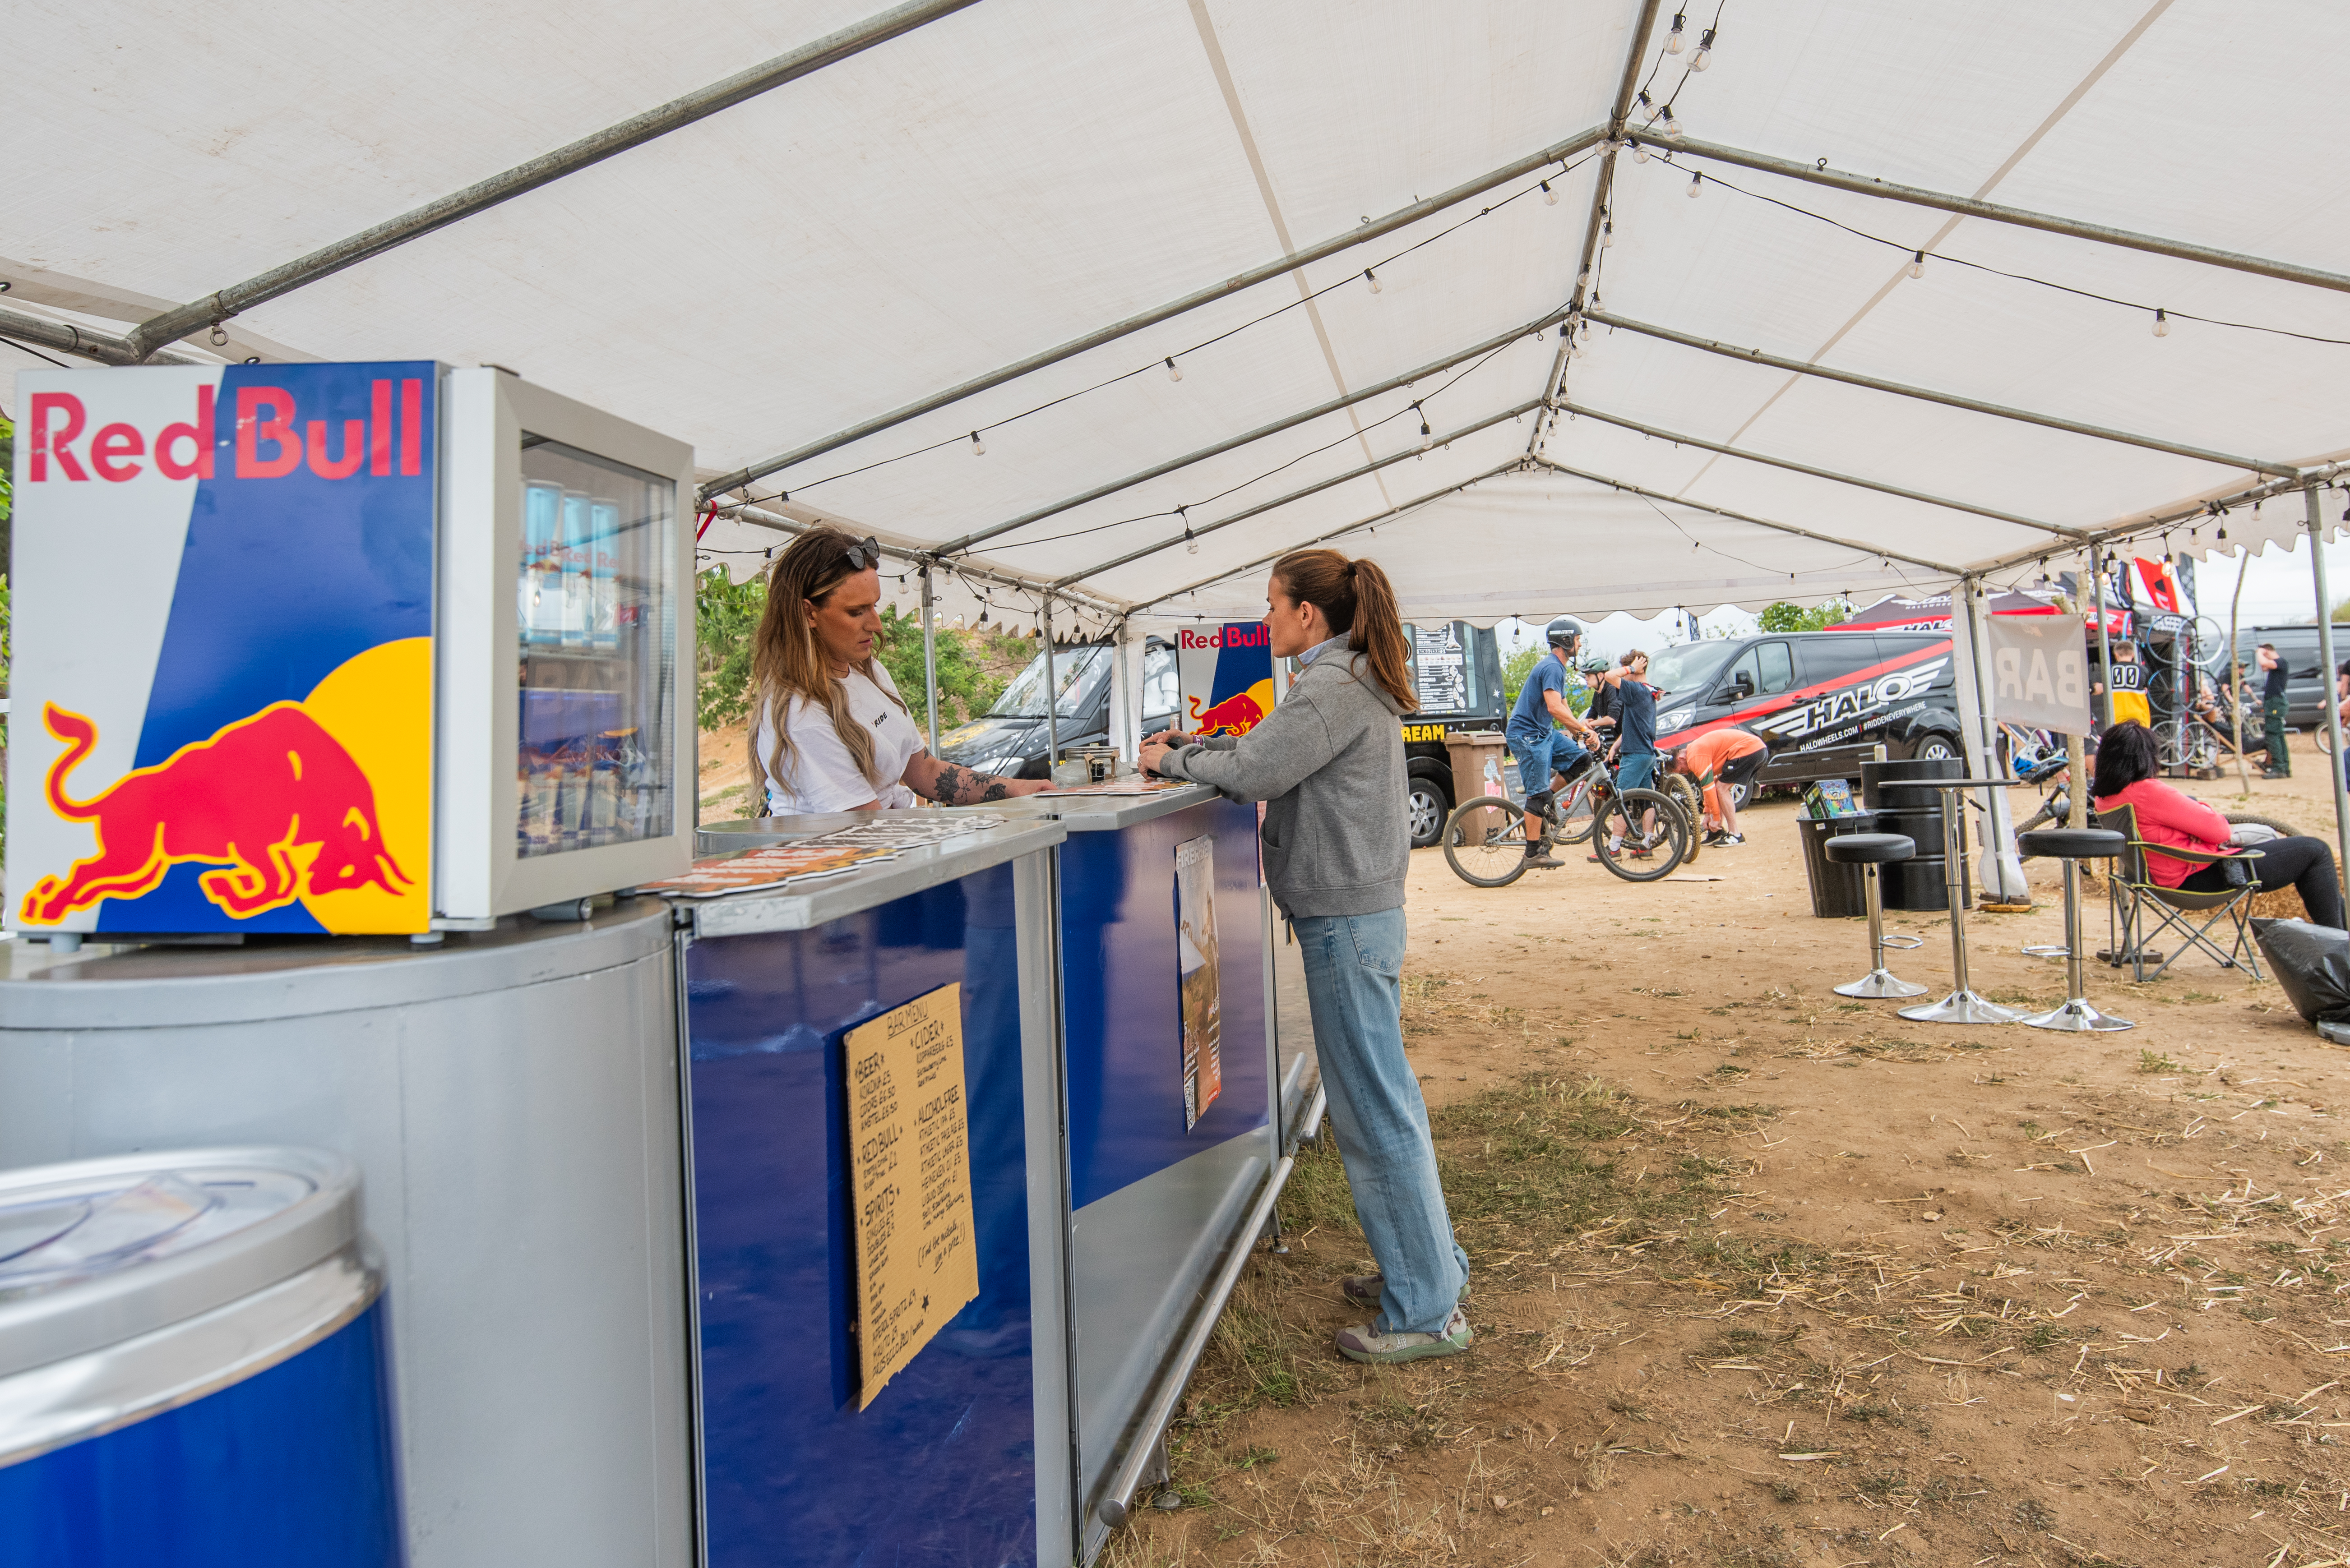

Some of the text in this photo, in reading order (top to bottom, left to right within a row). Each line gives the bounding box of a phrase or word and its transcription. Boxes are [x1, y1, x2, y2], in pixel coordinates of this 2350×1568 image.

[28, 378, 423, 483] Red Bull
[1180, 624, 1268, 650] Red Bull
[874, 711, 888, 728] RIDE
[1401, 724, 1445, 742] REAM
[1799, 701, 1927, 752] HALOWHEELS.COM #RIDDENEVERYWHERE
[1176, 841, 1210, 871] FIRERIDE
[887, 1000, 928, 1036] BAR MENU
[914, 1019, 940, 1049] CIDER
[858, 1052, 880, 1083] BEER
[918, 1084, 959, 1125] ALCOHOL FREE
[861, 1122, 898, 1166] RED BULL
[865, 1184, 895, 1226] SPIRITS
